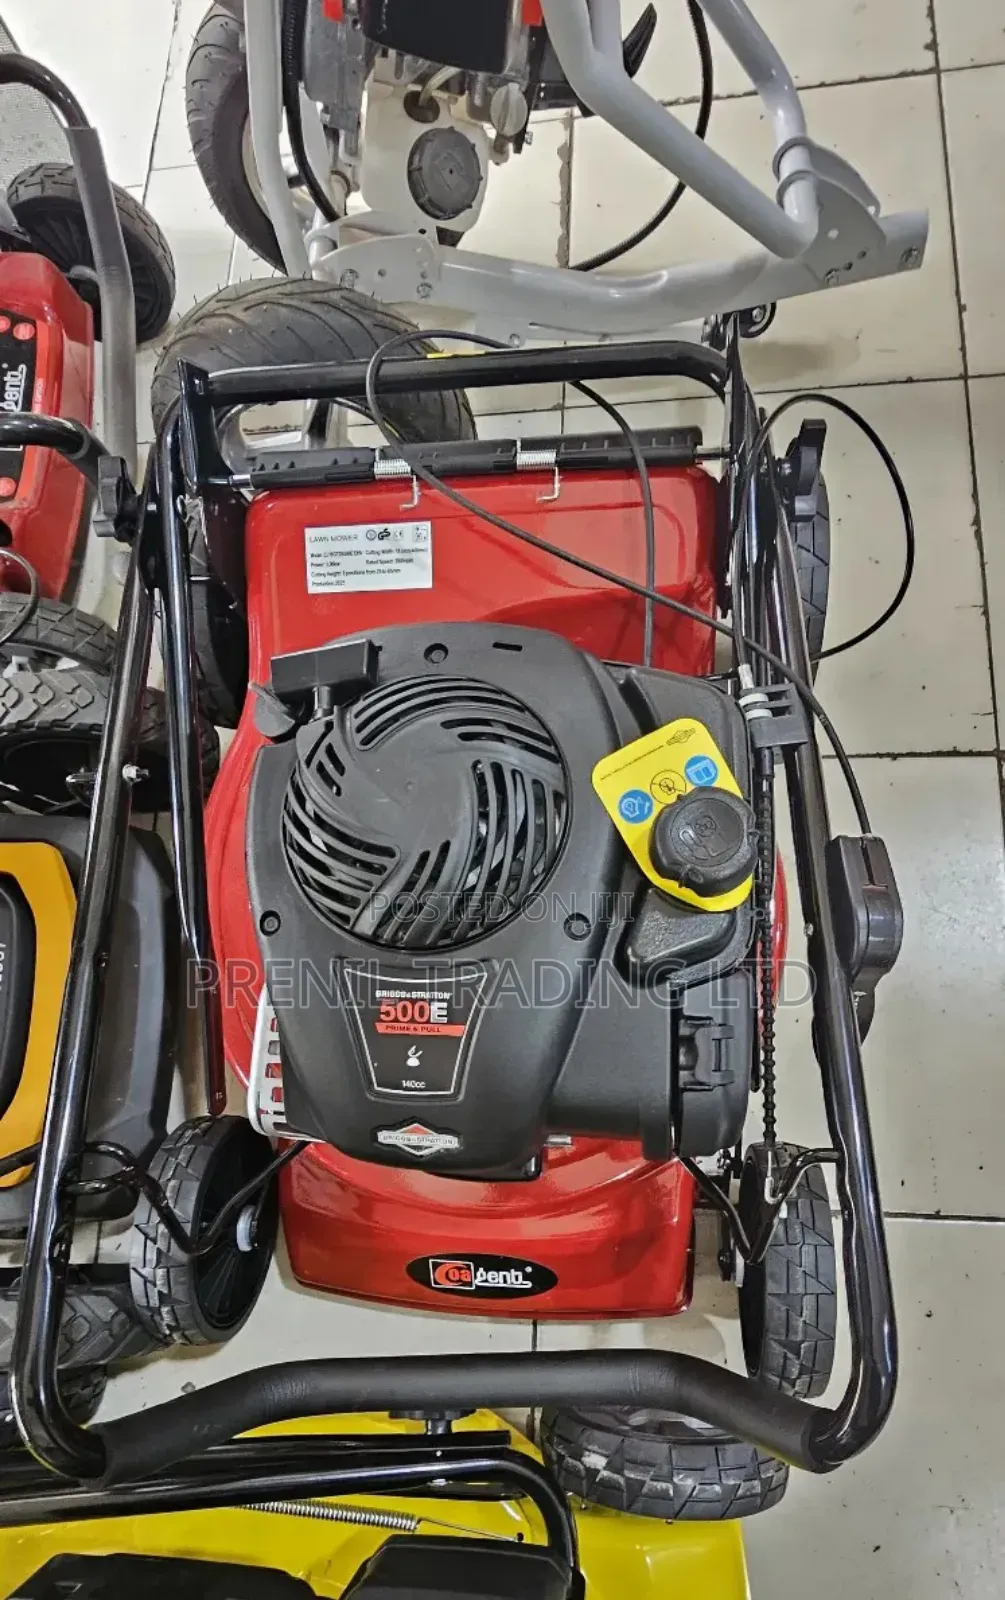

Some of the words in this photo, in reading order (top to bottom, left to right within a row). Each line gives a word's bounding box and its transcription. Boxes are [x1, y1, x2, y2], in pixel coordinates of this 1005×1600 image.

[330, 534, 359, 542] MOWER
[379, 1000, 448, 1023] 500E
[385, 1024, 412, 1032] PRIME
[420, 1025, 442, 1033] PULL
[401, 1079, 426, 1088] 140cc
